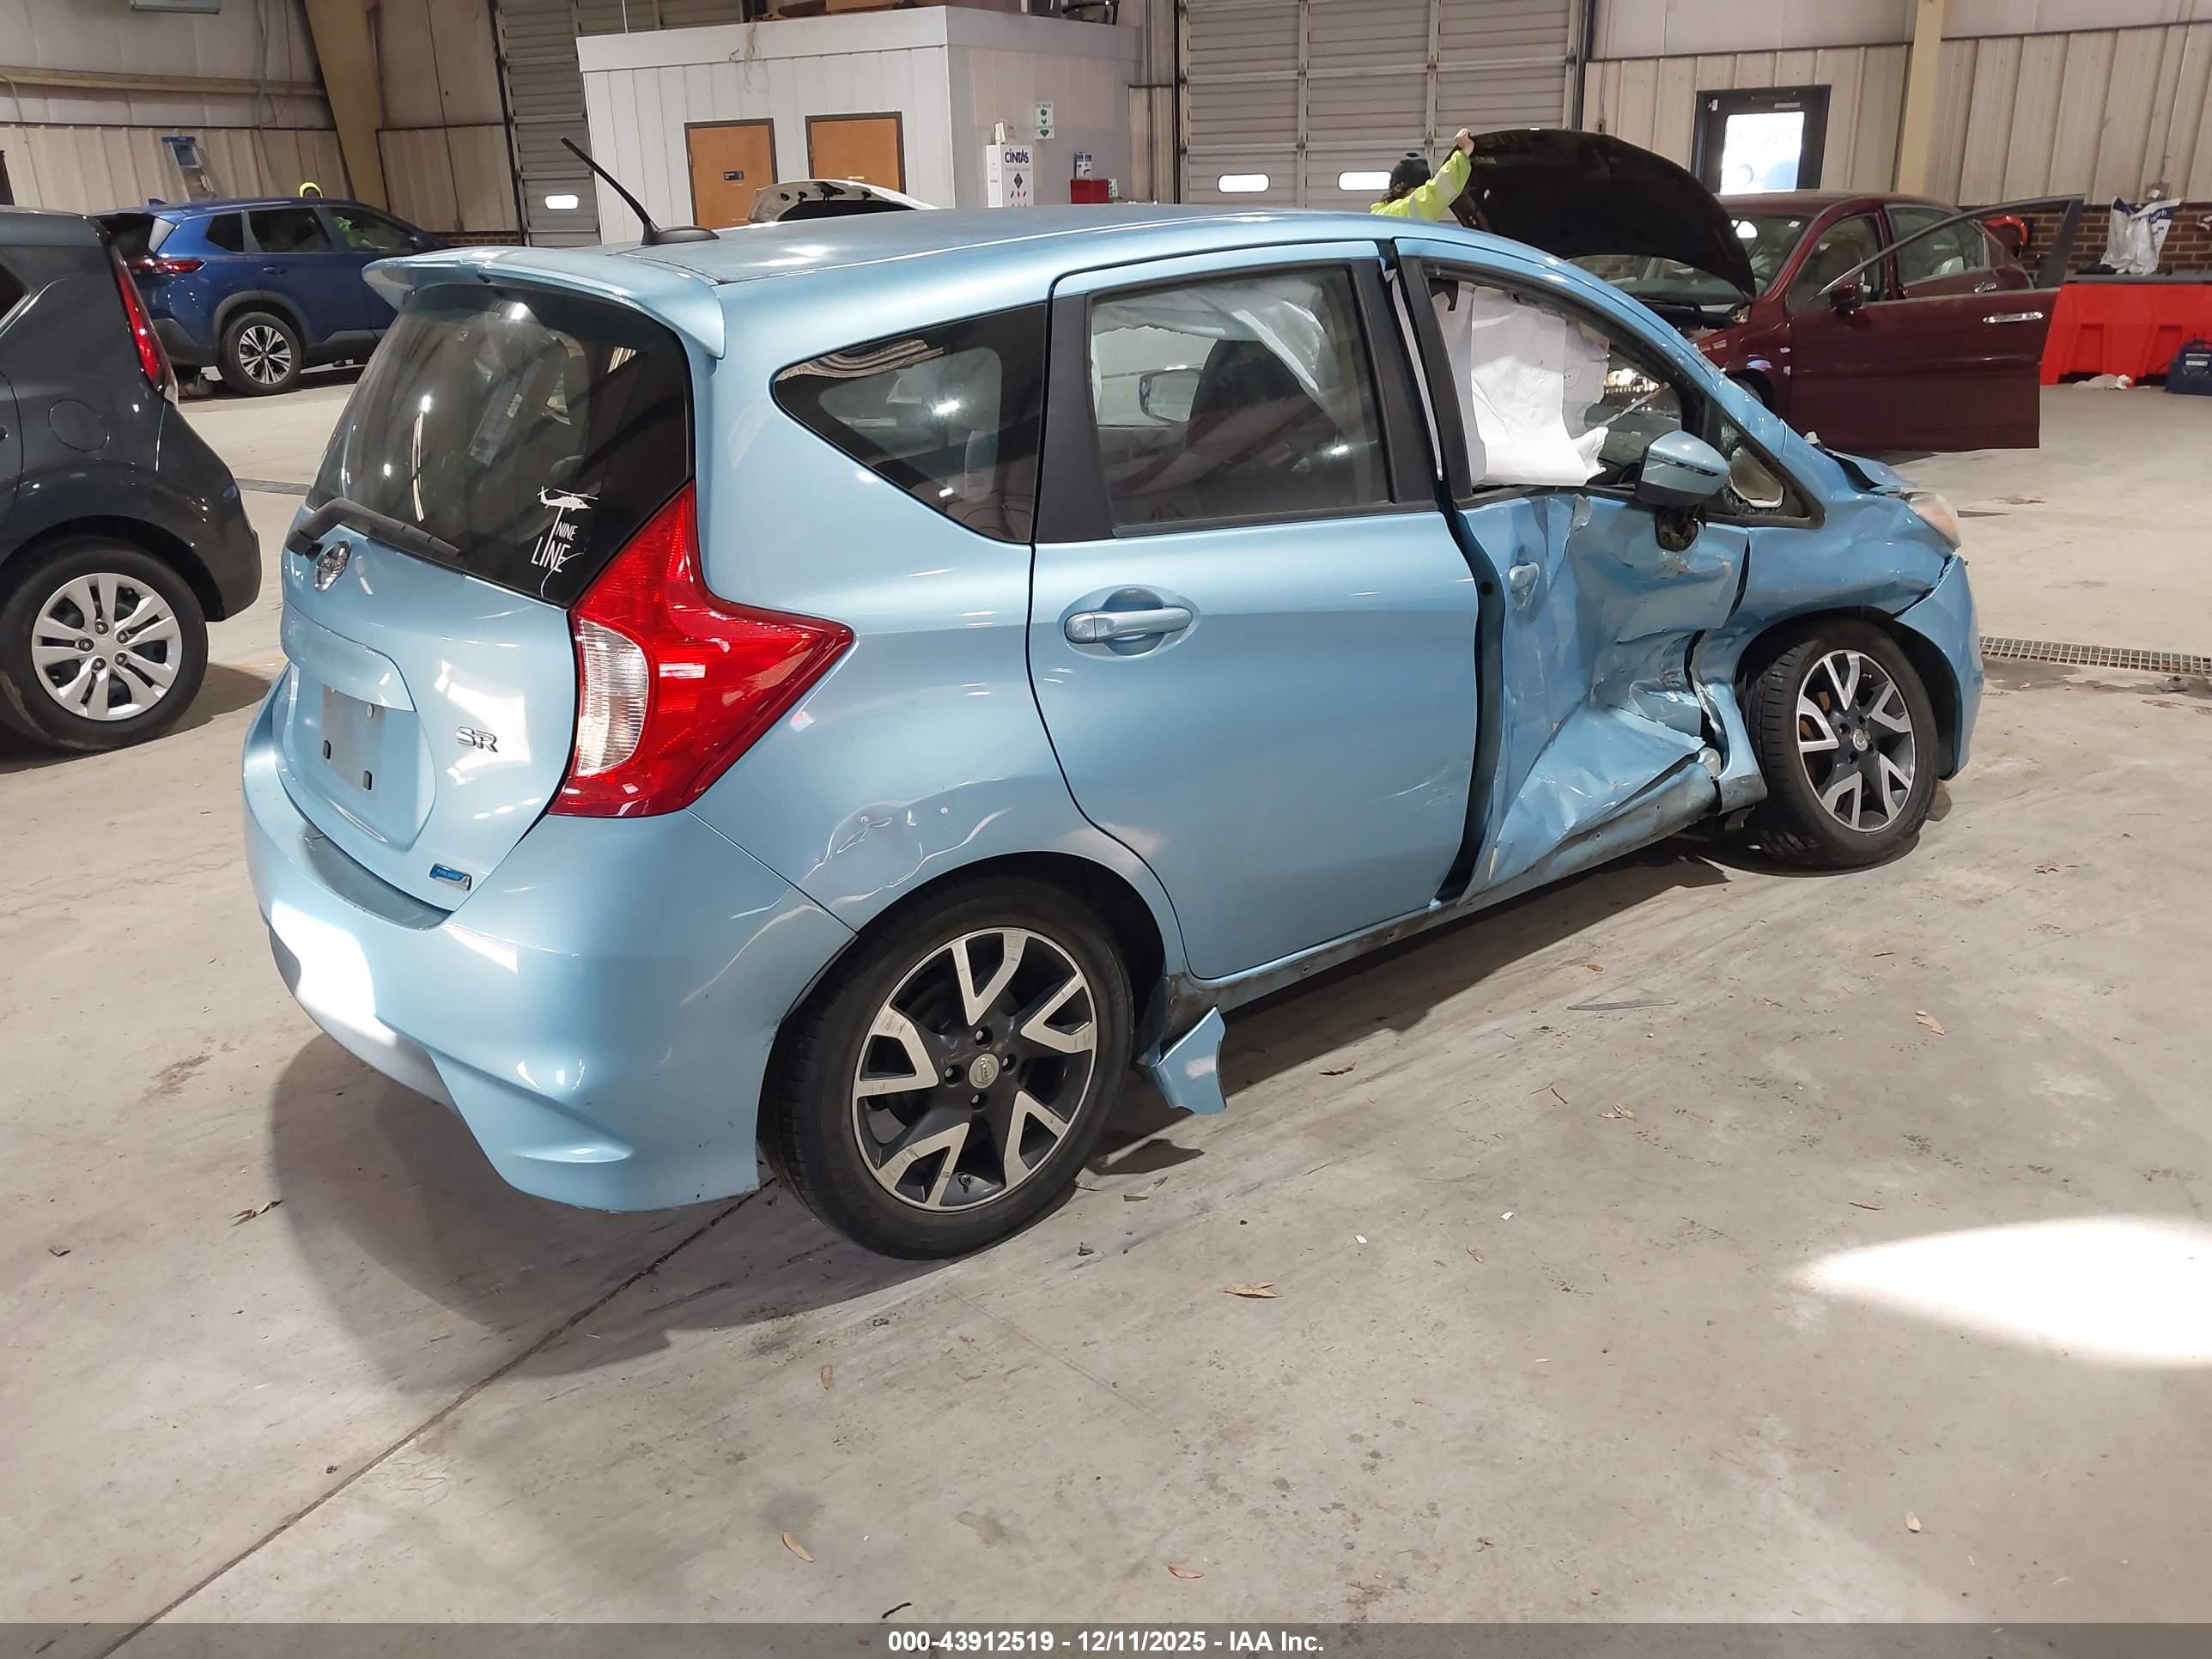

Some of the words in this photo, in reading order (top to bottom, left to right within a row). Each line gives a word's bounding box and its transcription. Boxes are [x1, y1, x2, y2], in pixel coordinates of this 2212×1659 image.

[556, 521, 579, 541] NINE
[531, 536, 571, 573] LINE
[456, 726, 498, 753] SR
